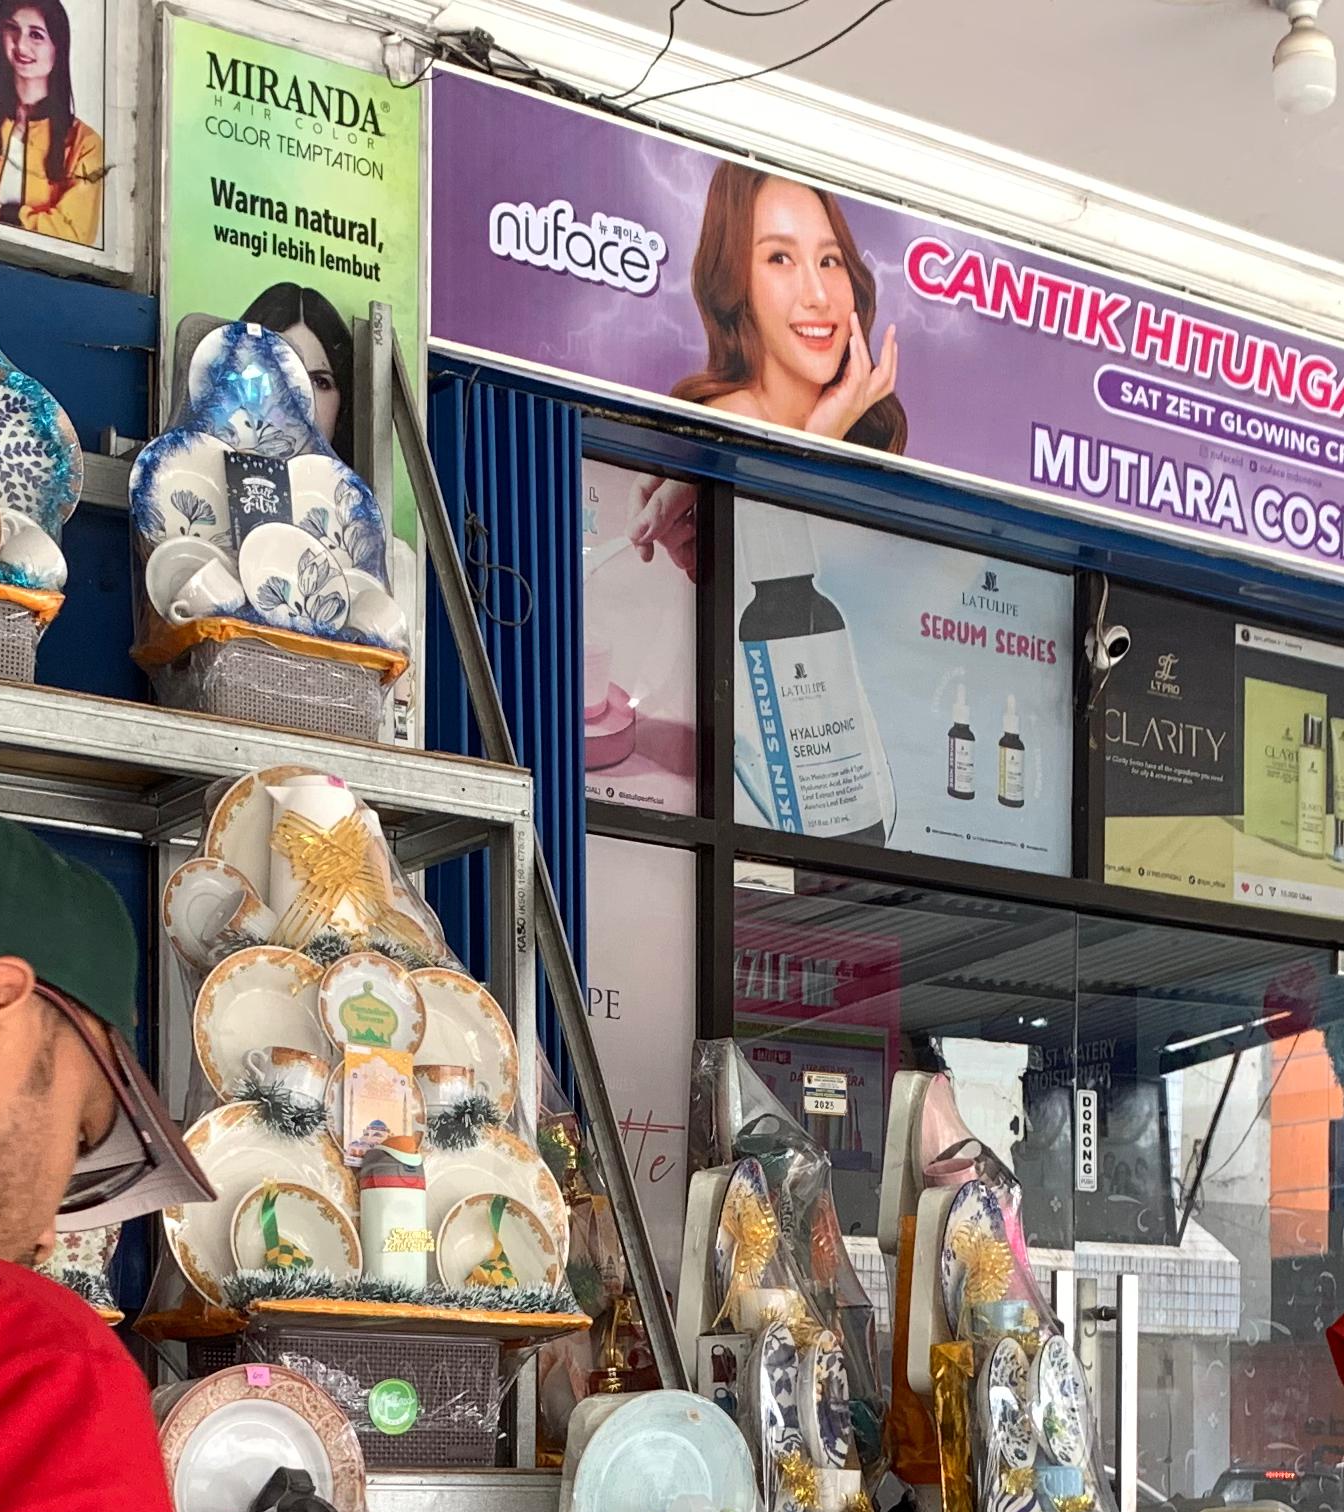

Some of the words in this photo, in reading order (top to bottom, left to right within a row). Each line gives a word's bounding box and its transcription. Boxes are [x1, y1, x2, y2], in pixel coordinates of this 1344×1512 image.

[206, 51, 386, 137] MIRANDA
[215, 95, 272, 120] HAIR
[295, 117, 375, 149] COLOR
[205, 116, 270, 150] COLOR
[277, 134, 384, 181] TEMPTATION
[210, 176, 288, 225] Warna
[294, 205, 384, 254] natural,
[214, 224, 268, 258] wangi
[272, 234, 315, 266] lebih
[320, 246, 381, 282] lembut
[906, 239, 1128, 351] CANTIK
[1120, 381, 1160, 411] SAT
[1165, 393, 1214, 428] ZETT
[1220, 410, 1320, 456] GLOWING
[1032, 425, 1245, 532] MUTIARA
[920, 612, 987, 648] SERUM
[749, 649, 780, 753] SERUM
[1150, 679, 1161, 691] LT
[1162, 682, 1180, 695] PRO
[789, 718, 855, 741] HYALURONIC
[794, 742, 831, 759] SERUM
[772, 765, 795, 834] SKIN
[517, 917, 526, 953] KASO
[1082, 1096, 1092, 1174] DORONG
